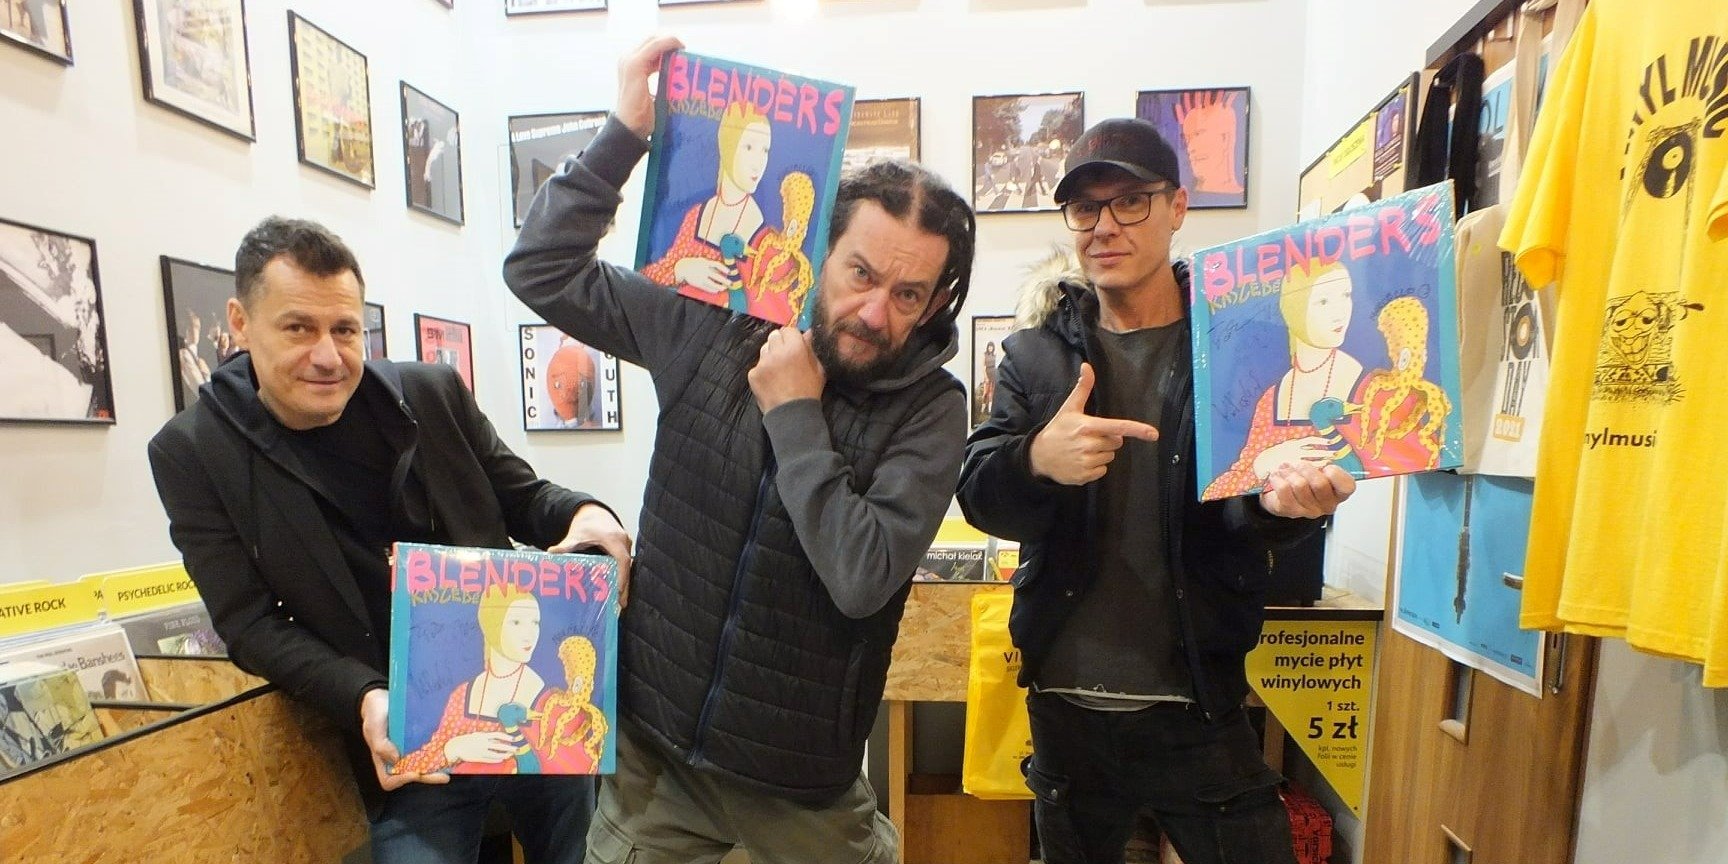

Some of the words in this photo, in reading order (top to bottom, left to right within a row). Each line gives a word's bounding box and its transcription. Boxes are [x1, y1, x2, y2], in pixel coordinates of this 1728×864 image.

[667, 53, 845, 135] BLENDERS
[1203, 193, 1442, 302] BLENDERS
[524, 328, 537, 418] SONIC
[1501, 361, 1531, 417] DAY
[1494, 417, 1523, 440] 2021
[406, 551, 609, 602] BLENDERS
[117, 583, 175, 602] PSYCHEDELIC
[176, 580, 197, 591] ROC
[34, 597, 66, 613] ROCK
[78, 652, 126, 670] Banshees
[1275, 652, 1324, 670] mycie
[1329, 652, 1363, 670] płyt
[1261, 674, 1361, 692] winylowych
[1327, 701, 1332, 711] 1
[1337, 701, 1360, 711] szt.
[1308, 716, 1324, 739] 5
[1332, 715, 1359, 739] zł
